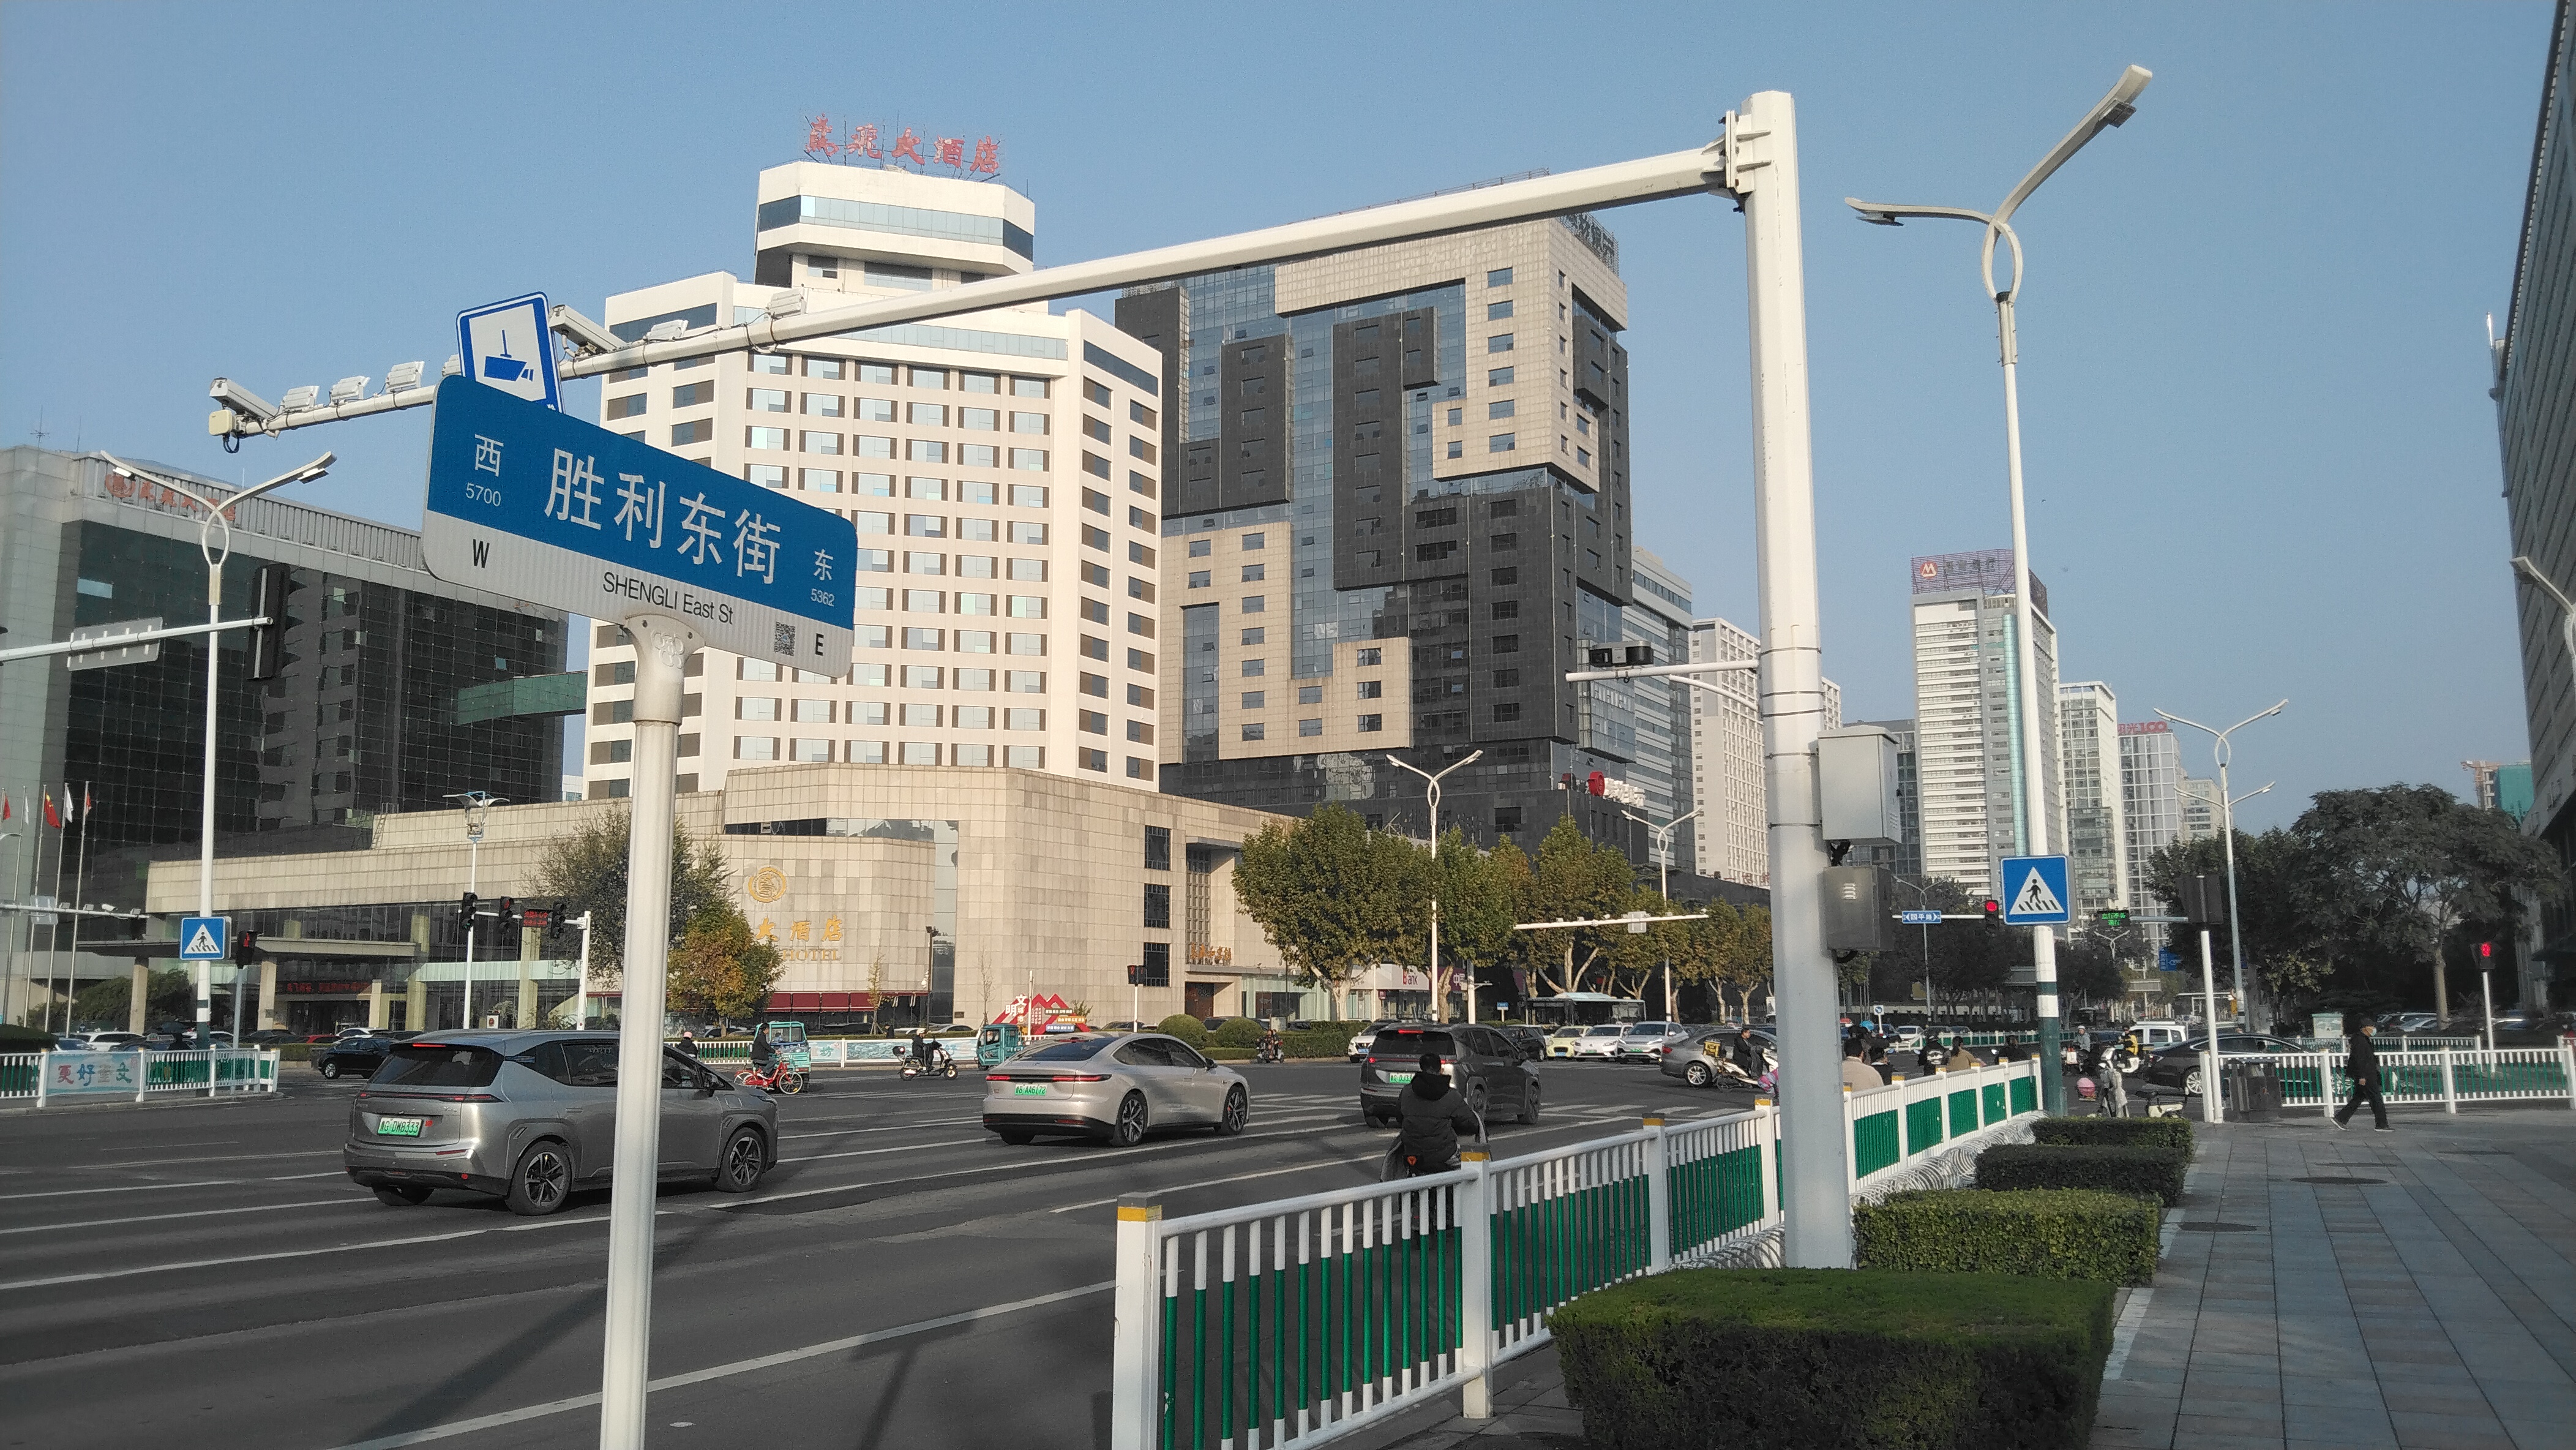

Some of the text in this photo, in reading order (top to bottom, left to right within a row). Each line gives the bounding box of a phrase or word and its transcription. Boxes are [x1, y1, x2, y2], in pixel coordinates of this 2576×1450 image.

[474, 434, 504, 478] 西
[465, 482, 502, 508] 5700
[544, 447, 781, 585] 胜利东街
[472, 538, 490, 569] W
[813, 548, 835, 581] 东
[602, 572, 734, 625] SHENGLI East St
[810, 587, 836, 607] 5362
[814, 633, 825, 656] E
[783, 949, 841, 961] HOTEL
